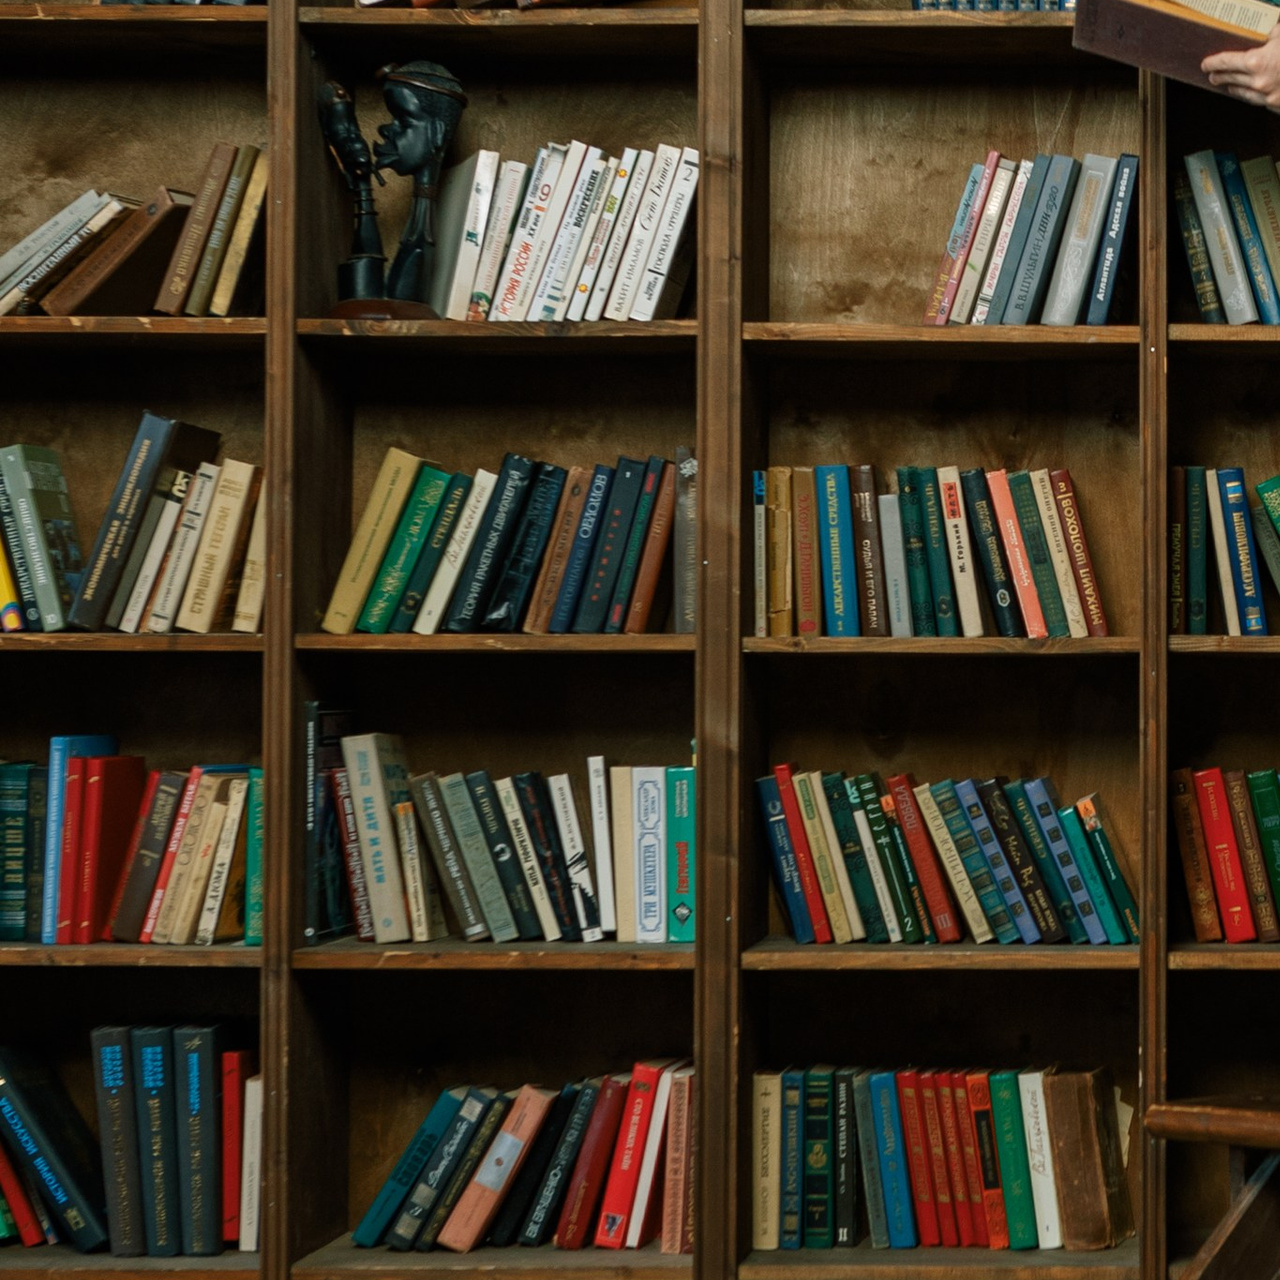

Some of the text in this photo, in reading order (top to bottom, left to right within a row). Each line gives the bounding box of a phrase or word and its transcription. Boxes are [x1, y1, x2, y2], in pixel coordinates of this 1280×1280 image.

[497, 278, 521, 315] ИСТОРИЯ
[510, 241, 534, 276] РОССИИ
[1096, 247, 1114, 301] Атлантида
[1062, 499, 1090, 565] ШОЛОХОВ
[1079, 568, 1104, 625] МИХАИЛ
[895, 785, 918, 829] ПОБЕДА
[32, 1156, 68, 1204] ИСТОРИЯ
